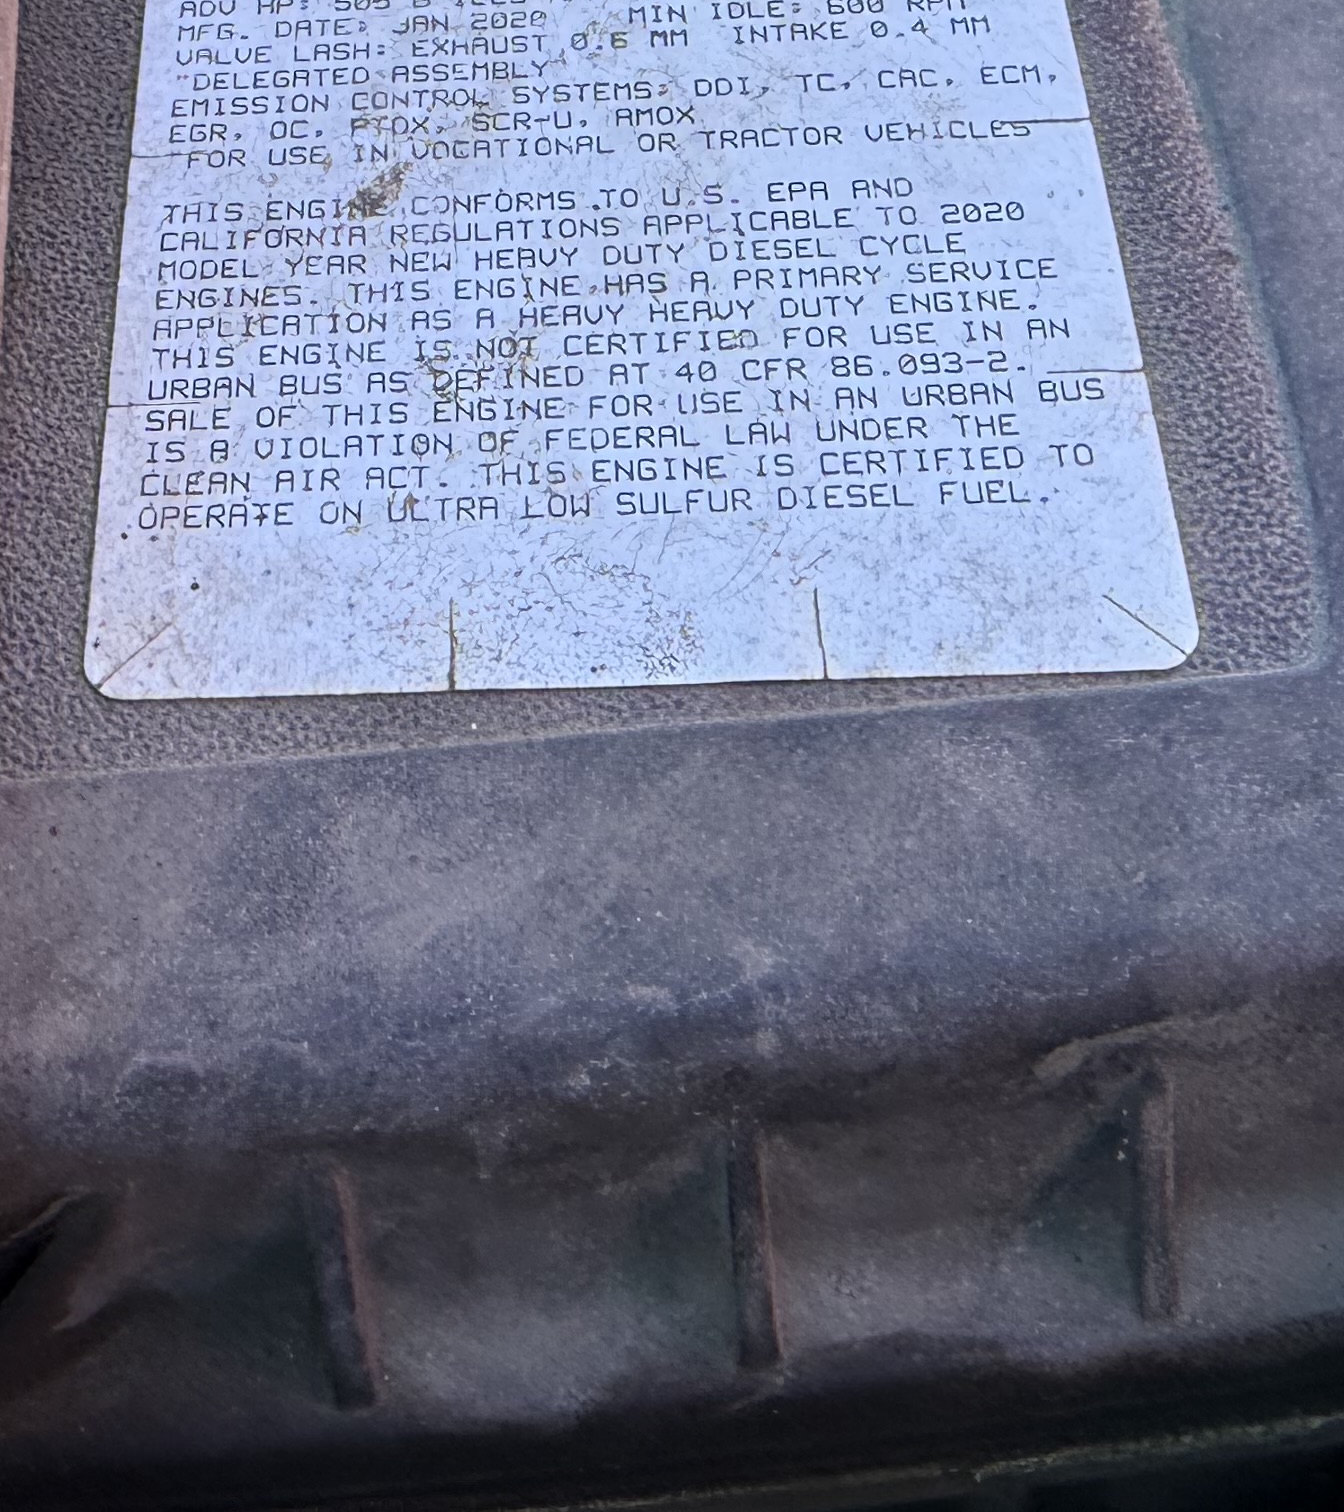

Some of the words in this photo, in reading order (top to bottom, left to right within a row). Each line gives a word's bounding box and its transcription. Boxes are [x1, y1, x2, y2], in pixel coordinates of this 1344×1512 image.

[178, 23, 249, 41] MFG.
[275, 18, 367, 40] DATE:
[392, 15, 449, 34] JAN
[470, 10, 546, 29] 2020
[628, 4, 687, 27] MIN
[712, 0, 801, 20] IDLE:
[179, 0, 236, 18] ADV
[177, 45, 272, 65] VALVE
[293, 42, 385, 61] LASH:
[412, 35, 546, 57] EXHAUST
[570, 32, 628, 50] 0.6
[650, 28, 688, 48] MM
[735, 22, 848, 45] INTAKE
[870, 19, 928, 38] 0.4
[950, 15, 991, 35] MM
[171, 94, 329, 117] EMISSION
[351, 88, 488, 110] CONTROL
[980, 65, 1056, 85] ECM,
[169, 123, 242, 143] EGR,
[270, 120, 323, 139] OC,
[616, 105, 696, 127] AMOX
[187, 149, 246, 169] FOR
[268, 146, 327, 165] USE
[354, 144, 388, 163] IN
[411, 134, 615, 160] VOCATIONAL
[638, 133, 676, 152] OR
[698, 126, 842, 150] TRACTOR
[865, 119, 1031, 142] VEHICLES
[160, 225, 367, 252] CALIFORNIA
[390, 215, 620, 246] REGULATIONS
[643, 208, 854, 236] APPLICABLE
[875, 206, 917, 227] TO
[941, 201, 1024, 224] 2020
[164, 202, 243, 225] THIS
[411, 191, 576, 216] CONFORMS
[601, 189, 638, 209] TO
[661, 186, 740, 208] U.S.
[768, 182, 829, 203] EPA
[852, 177, 913, 199] AND
[157, 260, 258, 281] MODEL
[285, 254, 367, 278] YEAR
[389, 253, 451, 273] NEW
[475, 246, 578, 271] HEAVY
[602, 243, 685, 266] DUTY
[709, 238, 837, 262] DIESEL
[859, 232, 966, 257] CYCLE
[156, 287, 317, 310] ENGINES.
[348, 280, 430, 305] THIS
[455, 275, 581, 302] ENGINE
[604, 272, 668, 297] HAS
[690, 270, 709, 291] A
[733, 266, 882, 290] PRIMARY
[907, 258, 1058, 284] SERVICE
[154, 312, 388, 340] APPLICATION
[411, 309, 452, 331] AS
[476, 307, 495, 329] A
[518, 302, 623, 328] HEAVY
[649, 300, 754, 325] HEAVY
[780, 295, 865, 320] DUTY
[890, 289, 1038, 316] ENGINE.
[154, 347, 234, 370] THIS
[259, 342, 386, 367] ENGINE
[414, 341, 452, 362] IS
[476, 336, 539, 361] NOT
[563, 329, 758, 356] CERTIFIED
[783, 326, 847, 349] FOR
[871, 323, 934, 346] USE
[964, 320, 1004, 342] IN
[1028, 319, 1070, 341] AN
[148, 377, 255, 401] URBAN
[280, 373, 342, 397] BUS
[367, 372, 410, 394] AS
[432, 365, 584, 393] DEFINED
[609, 361, 649, 386] AT
[675, 361, 717, 383] 40
[742, 359, 809, 382] CFR
[831, 351, 1026, 378] 86.093-2.
[145, 407, 231, 431] SALE
[256, 404, 296, 429] OF
[323, 402, 409, 426] THIS
[433, 397, 564, 424] ENGINE
[588, 394, 653, 418] FOR
[678, 391, 743, 415] USE
[772, 389, 810, 413] IN
[834, 386, 878, 411] AN
[902, 379, 1016, 407] URBAN
[1039, 378, 1105, 403] BUS
[146, 440, 185, 464] IS
[209, 438, 229, 462] A
[255, 431, 452, 460] VIOLATION
[478, 430, 520, 453] OF
[546, 424, 700, 451] FEDERAL
[725, 420, 791, 445] LAW
[816, 416, 928, 443] UNDER
[953, 413, 1020, 438] THE
[141, 472, 250, 496] CLEAN
[275, 469, 340, 492] AIR
[366, 465, 448, 490] ACT.
[478, 461, 565, 486] THIS
[591, 455, 726, 483] ENGINE
[756, 453, 795, 477] IS
[820, 444, 1025, 476] CERTIFIED
[1051, 442, 1094, 468] TO
[139, 501, 294, 530] OPERATE
[319, 499, 362, 523] ON
[387, 494, 499, 522] ULTRA
[520, 494, 591, 519] LOW
[617, 488, 752, 517] SULFUR
[778, 484, 914, 511] DIESEL
[938, 477, 1050, 506] FUEL.
